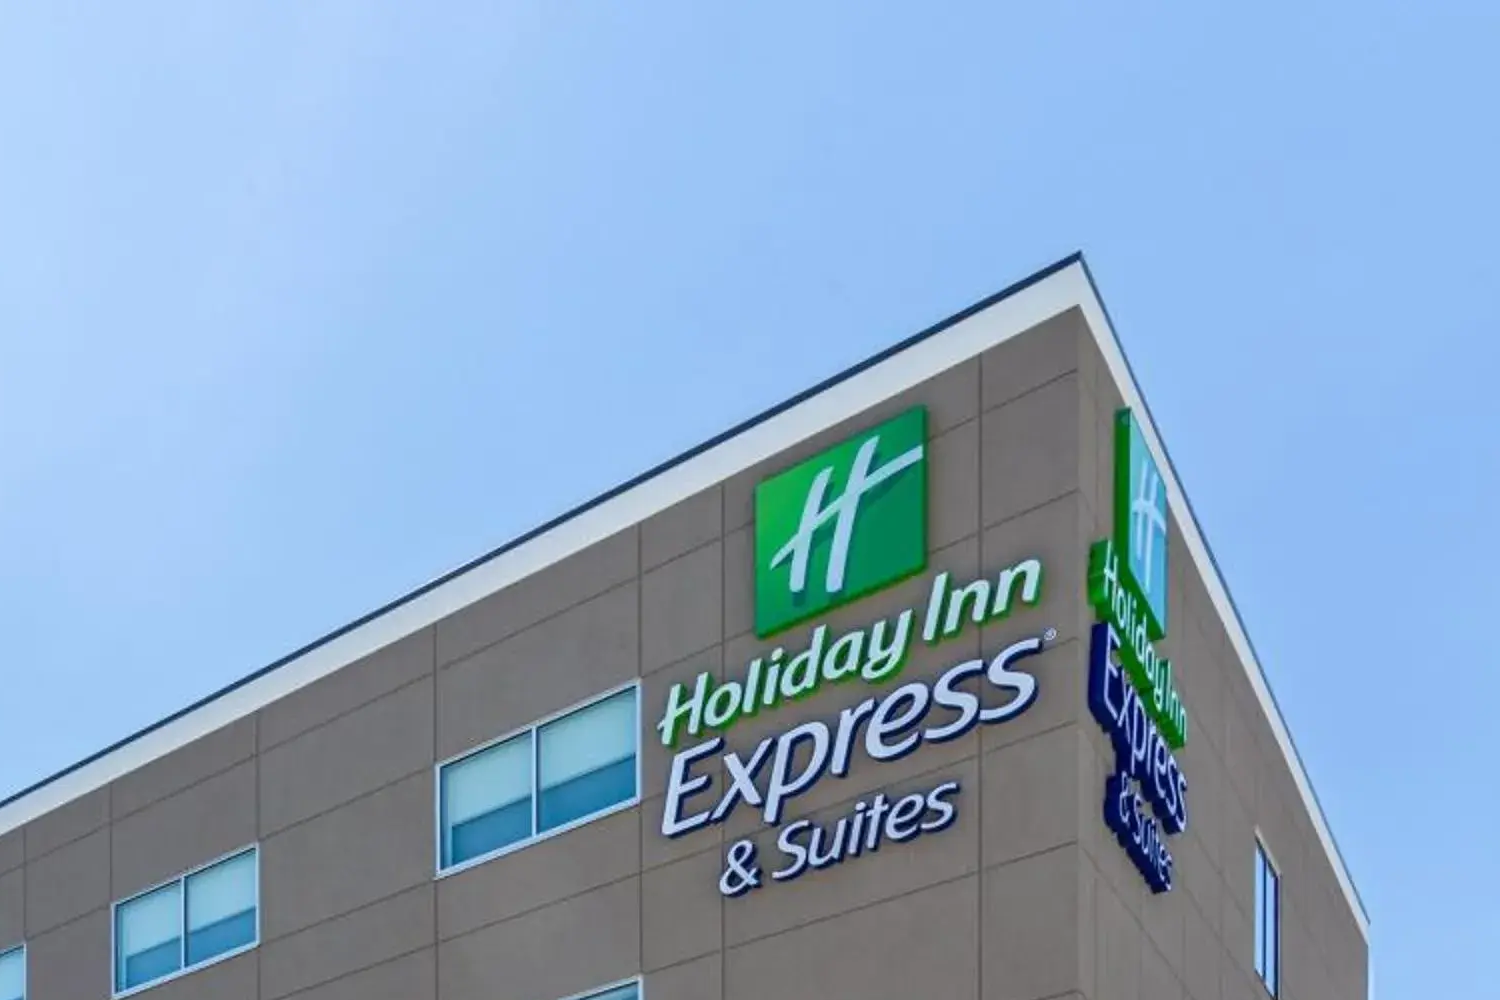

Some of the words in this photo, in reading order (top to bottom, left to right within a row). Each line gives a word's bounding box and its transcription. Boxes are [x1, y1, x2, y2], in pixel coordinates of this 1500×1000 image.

[769, 435, 924, 593] H
[657, 610, 913, 746] Holiday
[922, 558, 1042, 642] Inn
[1103, 540, 1165, 712] Holiday
[1166, 660, 1188, 743] Inn
[1104, 621, 1188, 832] Express
[661, 636, 1043, 836] Express
[718, 839, 759, 897] &
[772, 782, 960, 880] Suites
[1133, 793, 1173, 892] Suites
